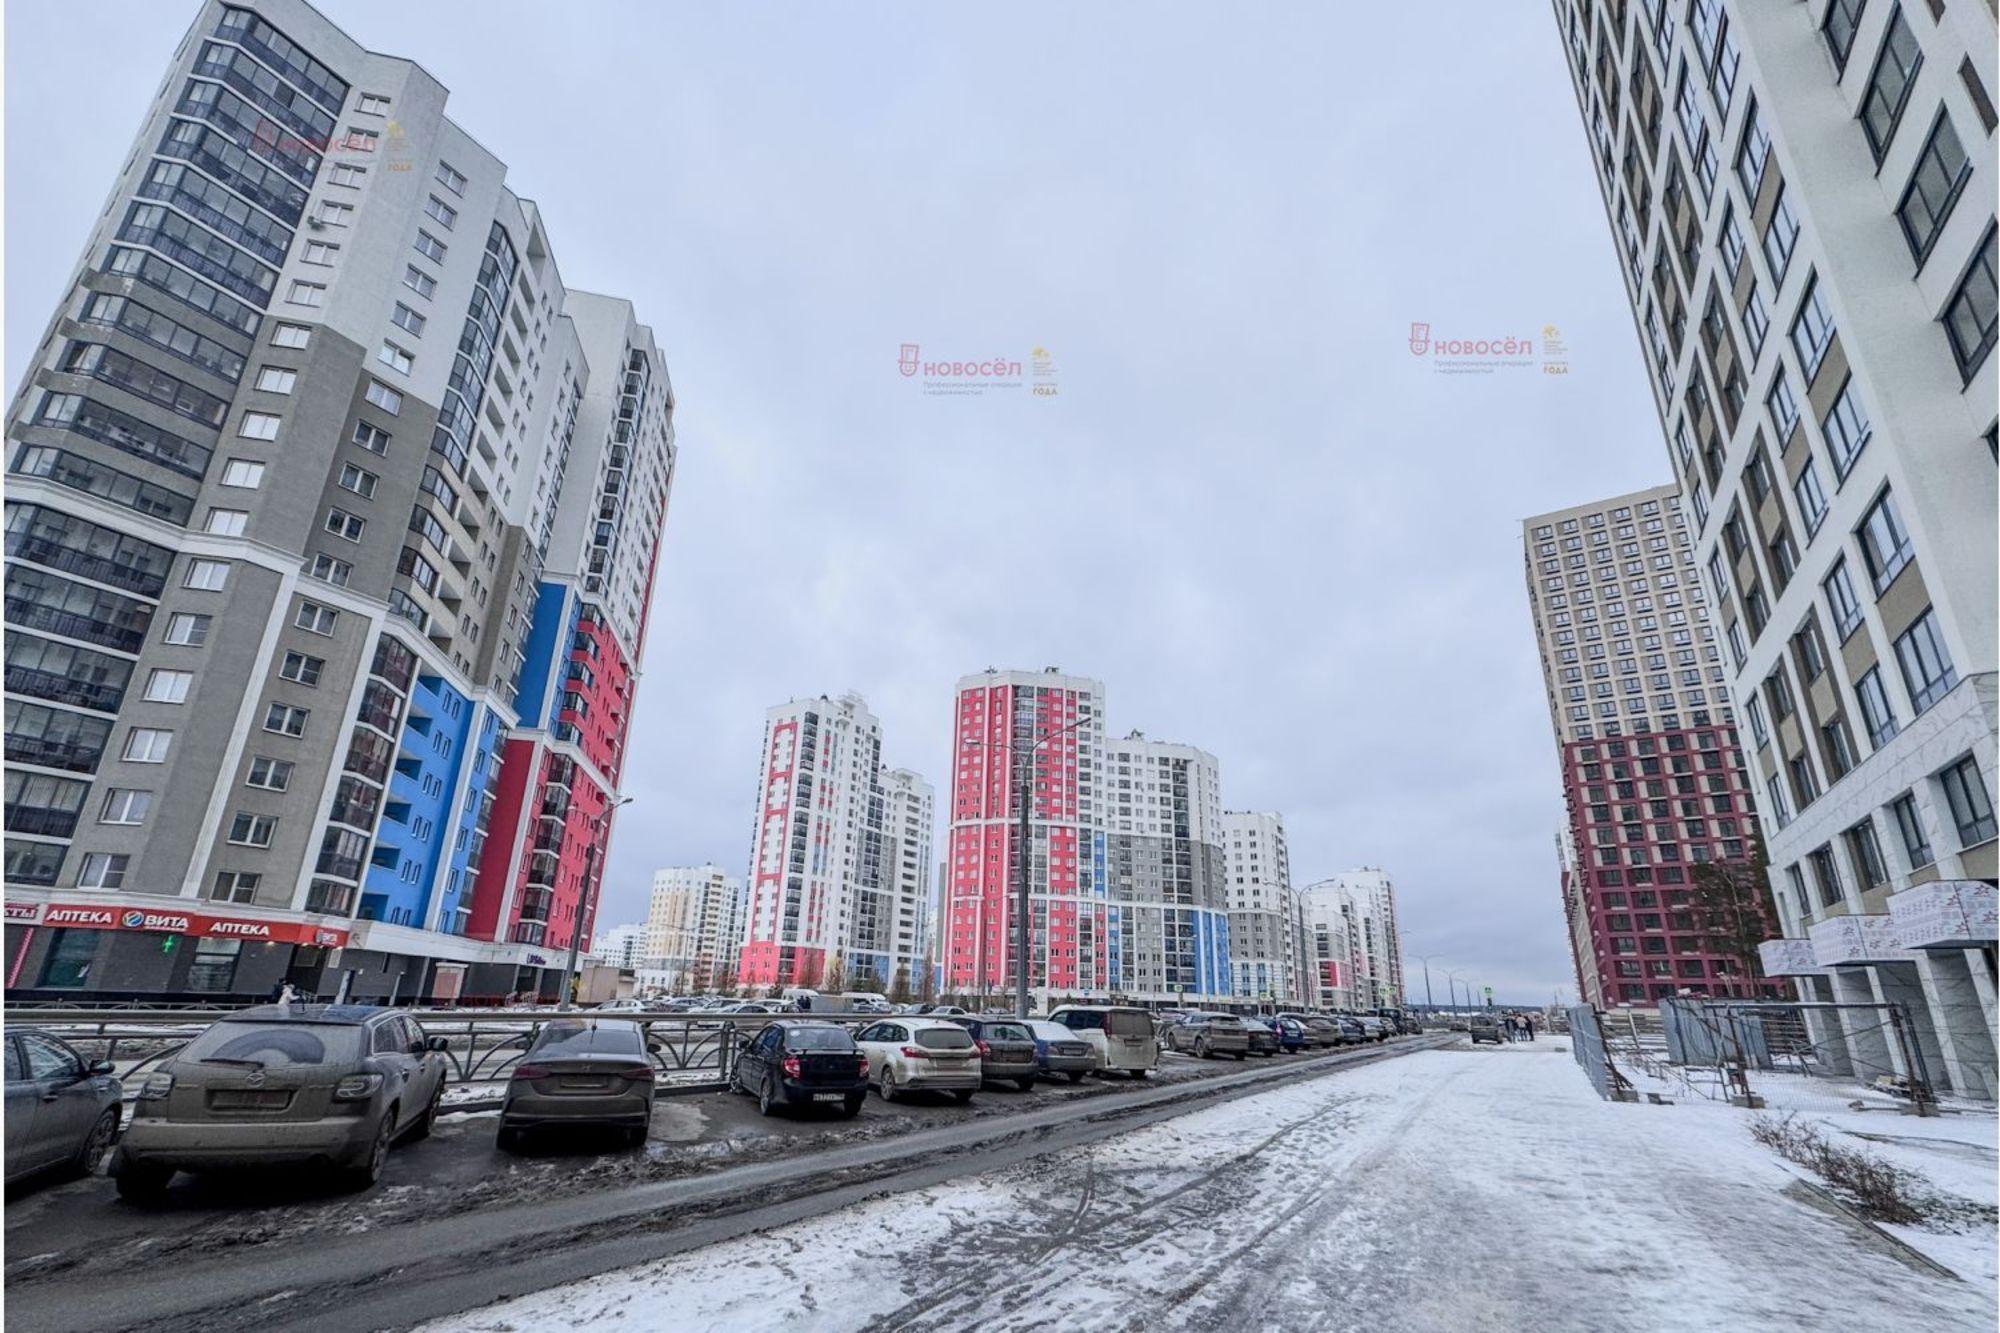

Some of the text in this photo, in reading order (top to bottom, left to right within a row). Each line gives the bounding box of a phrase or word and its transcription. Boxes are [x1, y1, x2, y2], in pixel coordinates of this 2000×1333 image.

[46, 910, 112, 923] АПТЕКА
[144, 915, 189, 928] ВИТА
[210, 922, 270, 936] АПТЕКА
